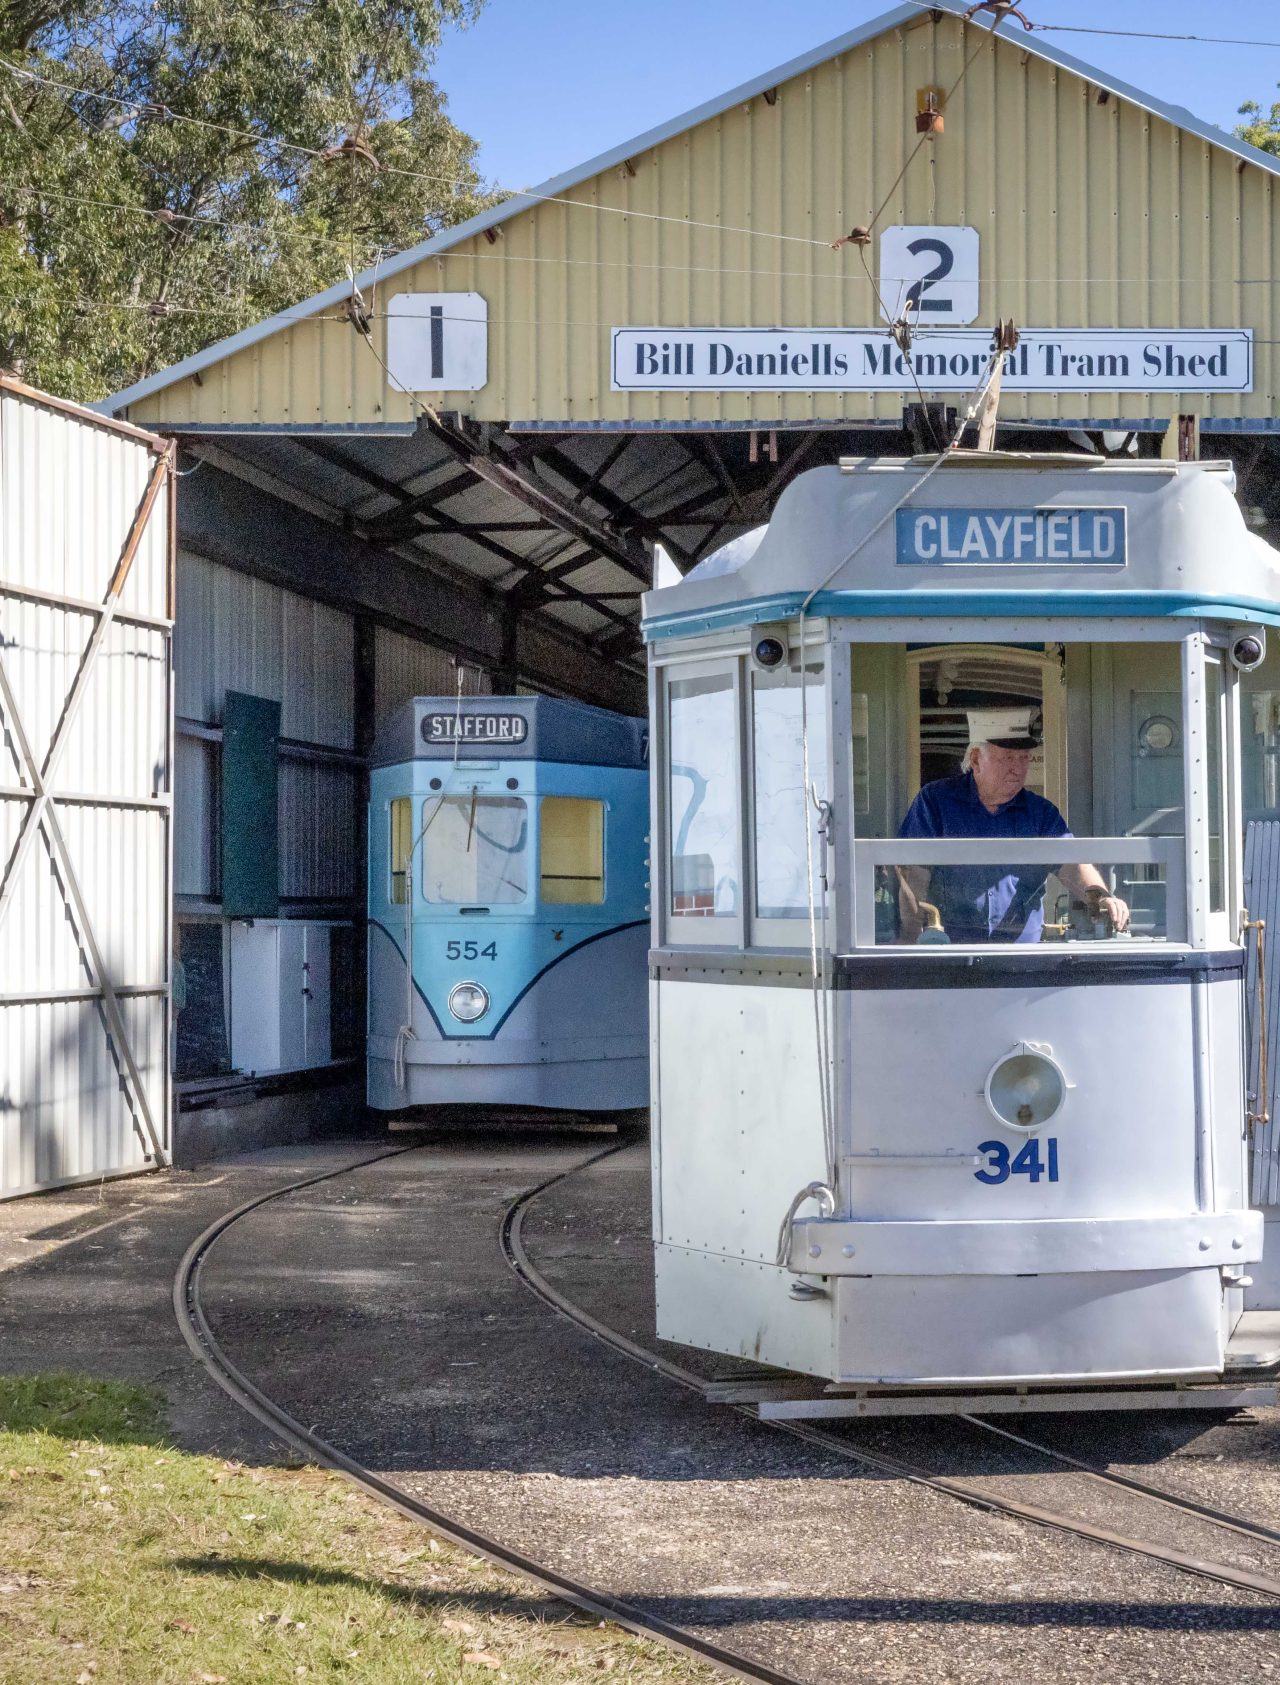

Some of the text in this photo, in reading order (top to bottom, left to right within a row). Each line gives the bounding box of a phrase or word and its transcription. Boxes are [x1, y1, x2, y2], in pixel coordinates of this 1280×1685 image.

[906, 238, 954, 312] 2
[430, 306, 443, 379] 1
[634, 342, 695, 376] Bill
[708, 343, 849, 377] Daniells
[1038, 344, 1130, 377] Tram
[1143, 343, 1229, 377] Shed
[914, 515, 1116, 559] CLAYFIELD
[432, 716, 522, 736] STAFFORD
[446, 940, 498, 961] 554
[974, 1138, 1059, 1185] 341
